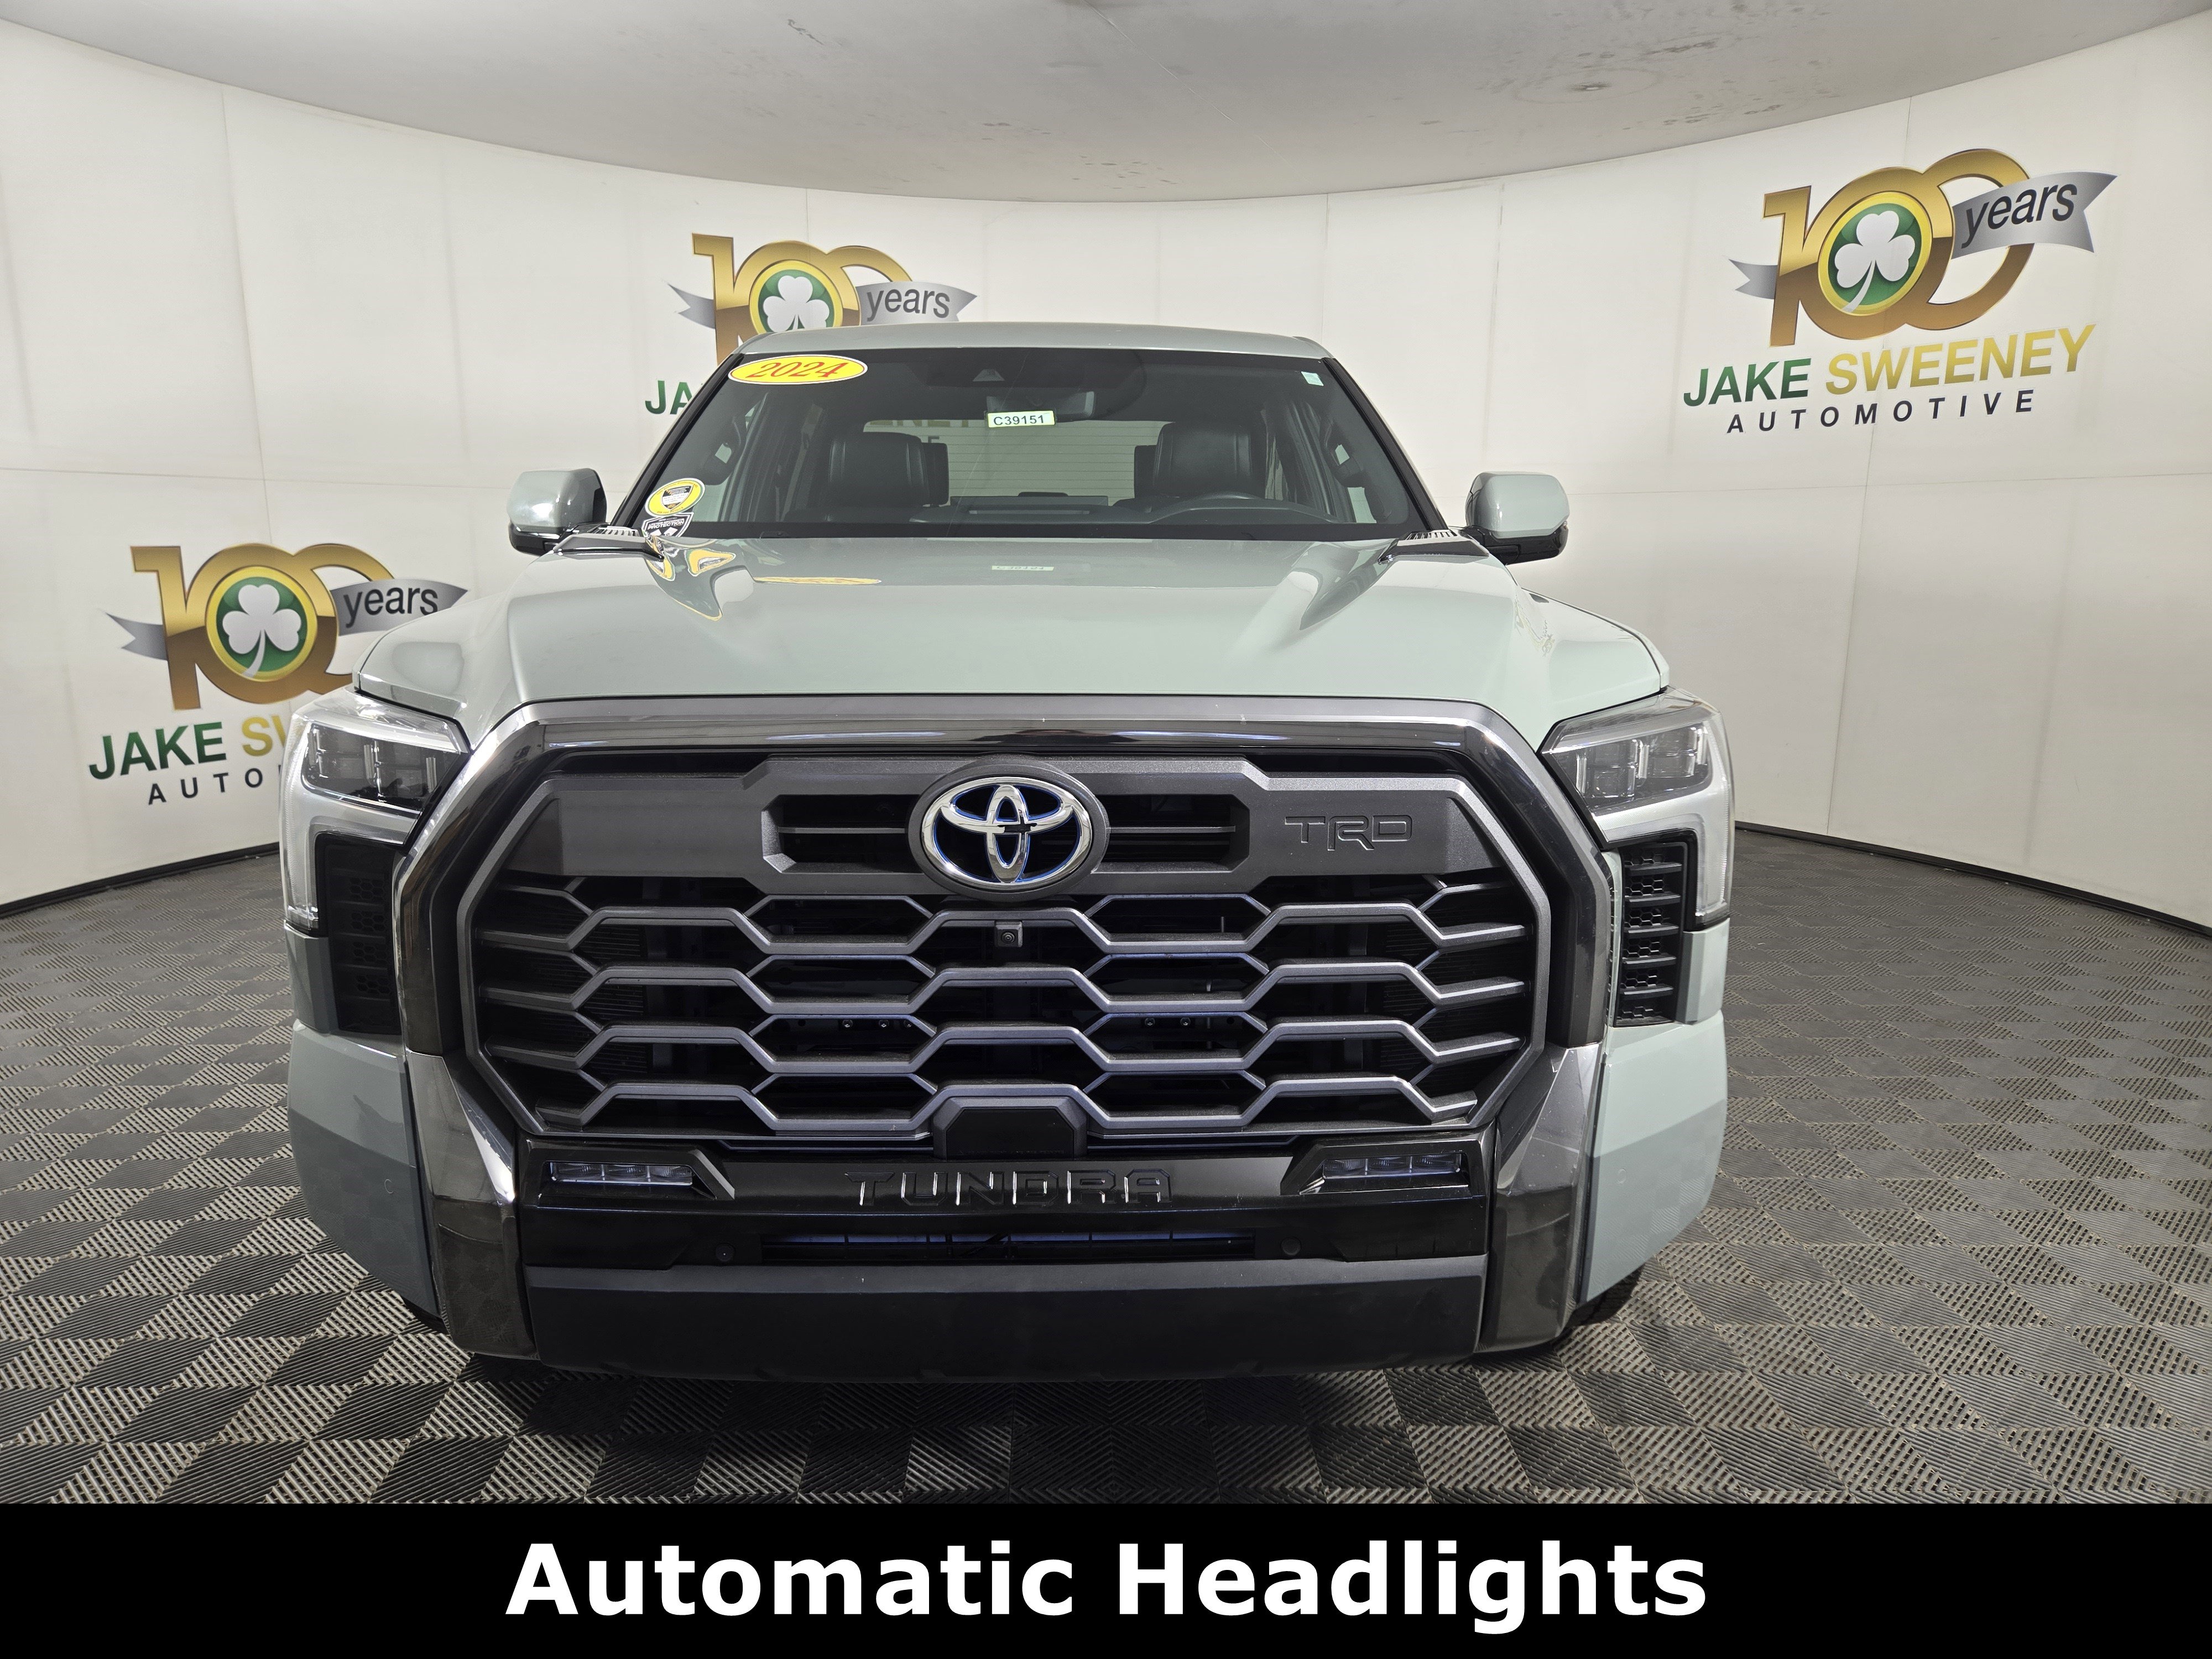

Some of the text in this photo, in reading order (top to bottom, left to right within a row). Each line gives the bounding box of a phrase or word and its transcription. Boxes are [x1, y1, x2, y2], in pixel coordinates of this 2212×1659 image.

[1961, 184, 2078, 249] years
[867, 289, 951, 320] years
[748, 362, 848, 378] 2024
[1684, 324, 2096, 406] JAKE SWEENEY
[645, 380, 692, 415] JA
[1726, 389, 2034, 434] AUTOMOTIVE
[993, 415, 1045, 426] C39151
[648, 519, 685, 530] PROTECTION
[344, 587, 439, 627] years
[89, 722, 227, 779] JAKE
[1285, 815, 1413, 851] TRD
[844, 1168, 1172, 1207] TUNDRA
